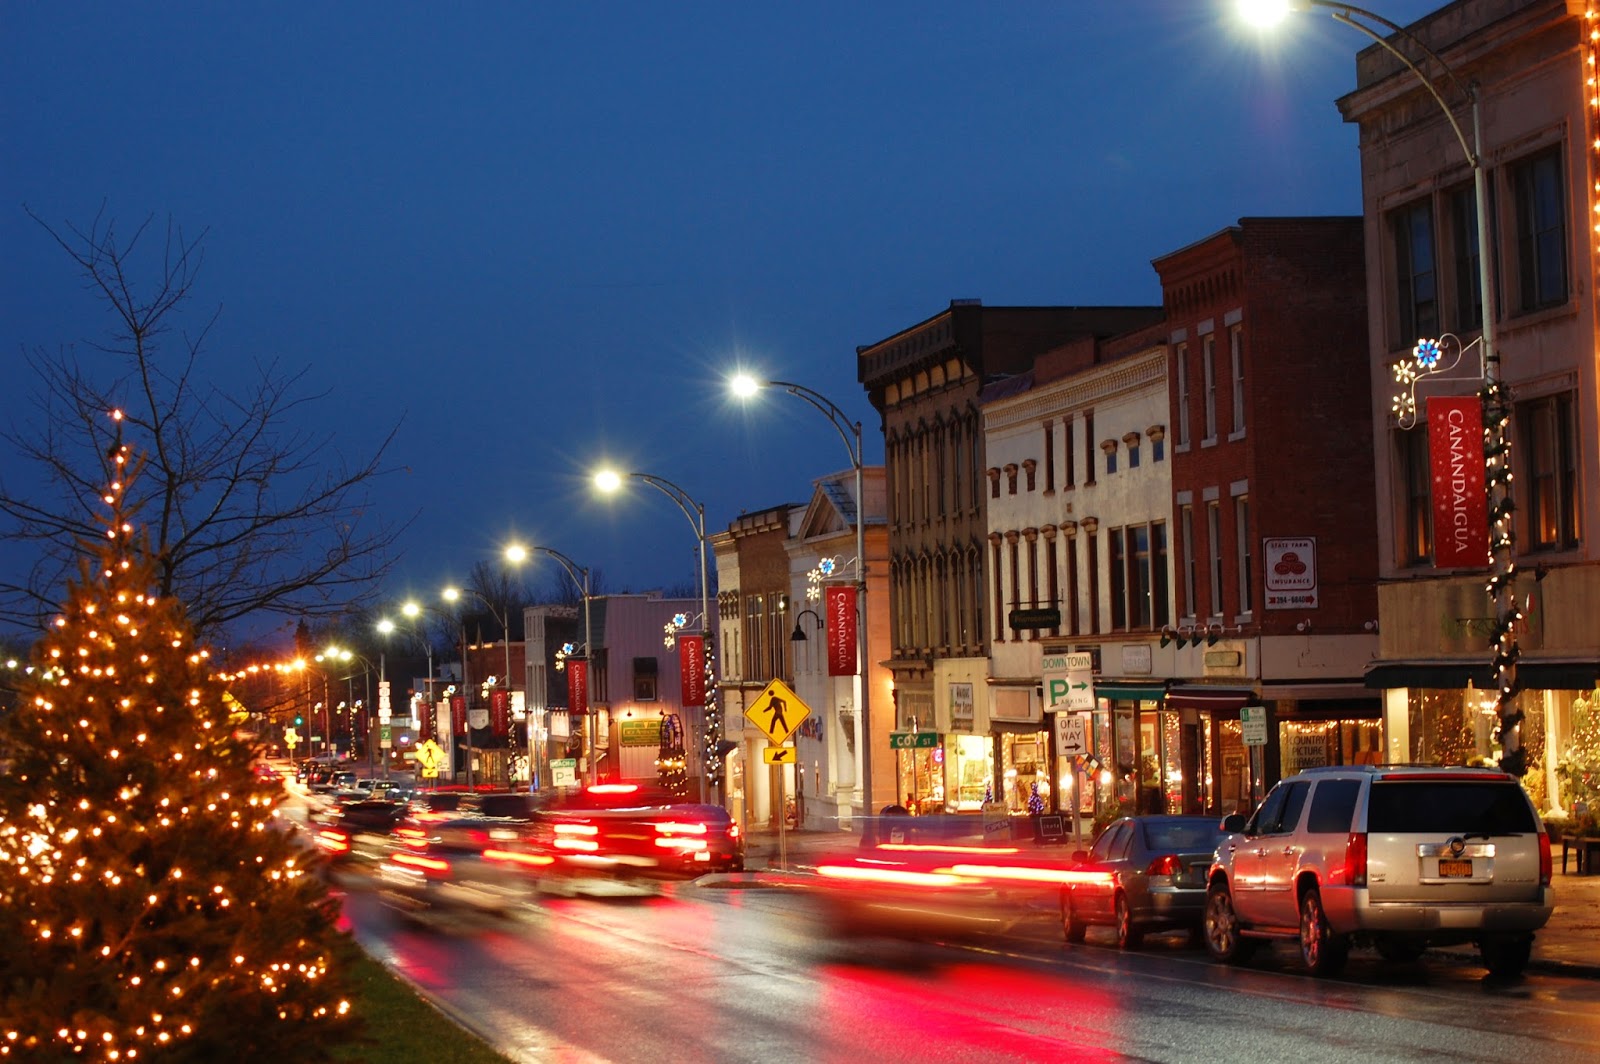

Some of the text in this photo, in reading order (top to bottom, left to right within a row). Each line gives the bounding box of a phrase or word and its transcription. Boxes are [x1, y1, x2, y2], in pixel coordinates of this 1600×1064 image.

[1447, 408, 1468, 554] CANANDAIGUA
[837, 592, 847, 669] CANANDAIGUA
[1042, 656, 1090, 669] DOWNTOWN
[688, 640, 697, 701] CANANDAIGUA
[1060, 719, 1080, 729] ONE
[896, 735, 919, 746] COY
[1060, 731, 1081, 741] WAY
[1289, 735, 1326, 745] COUNTRY
[1292, 746, 1323, 756] PICTURE
